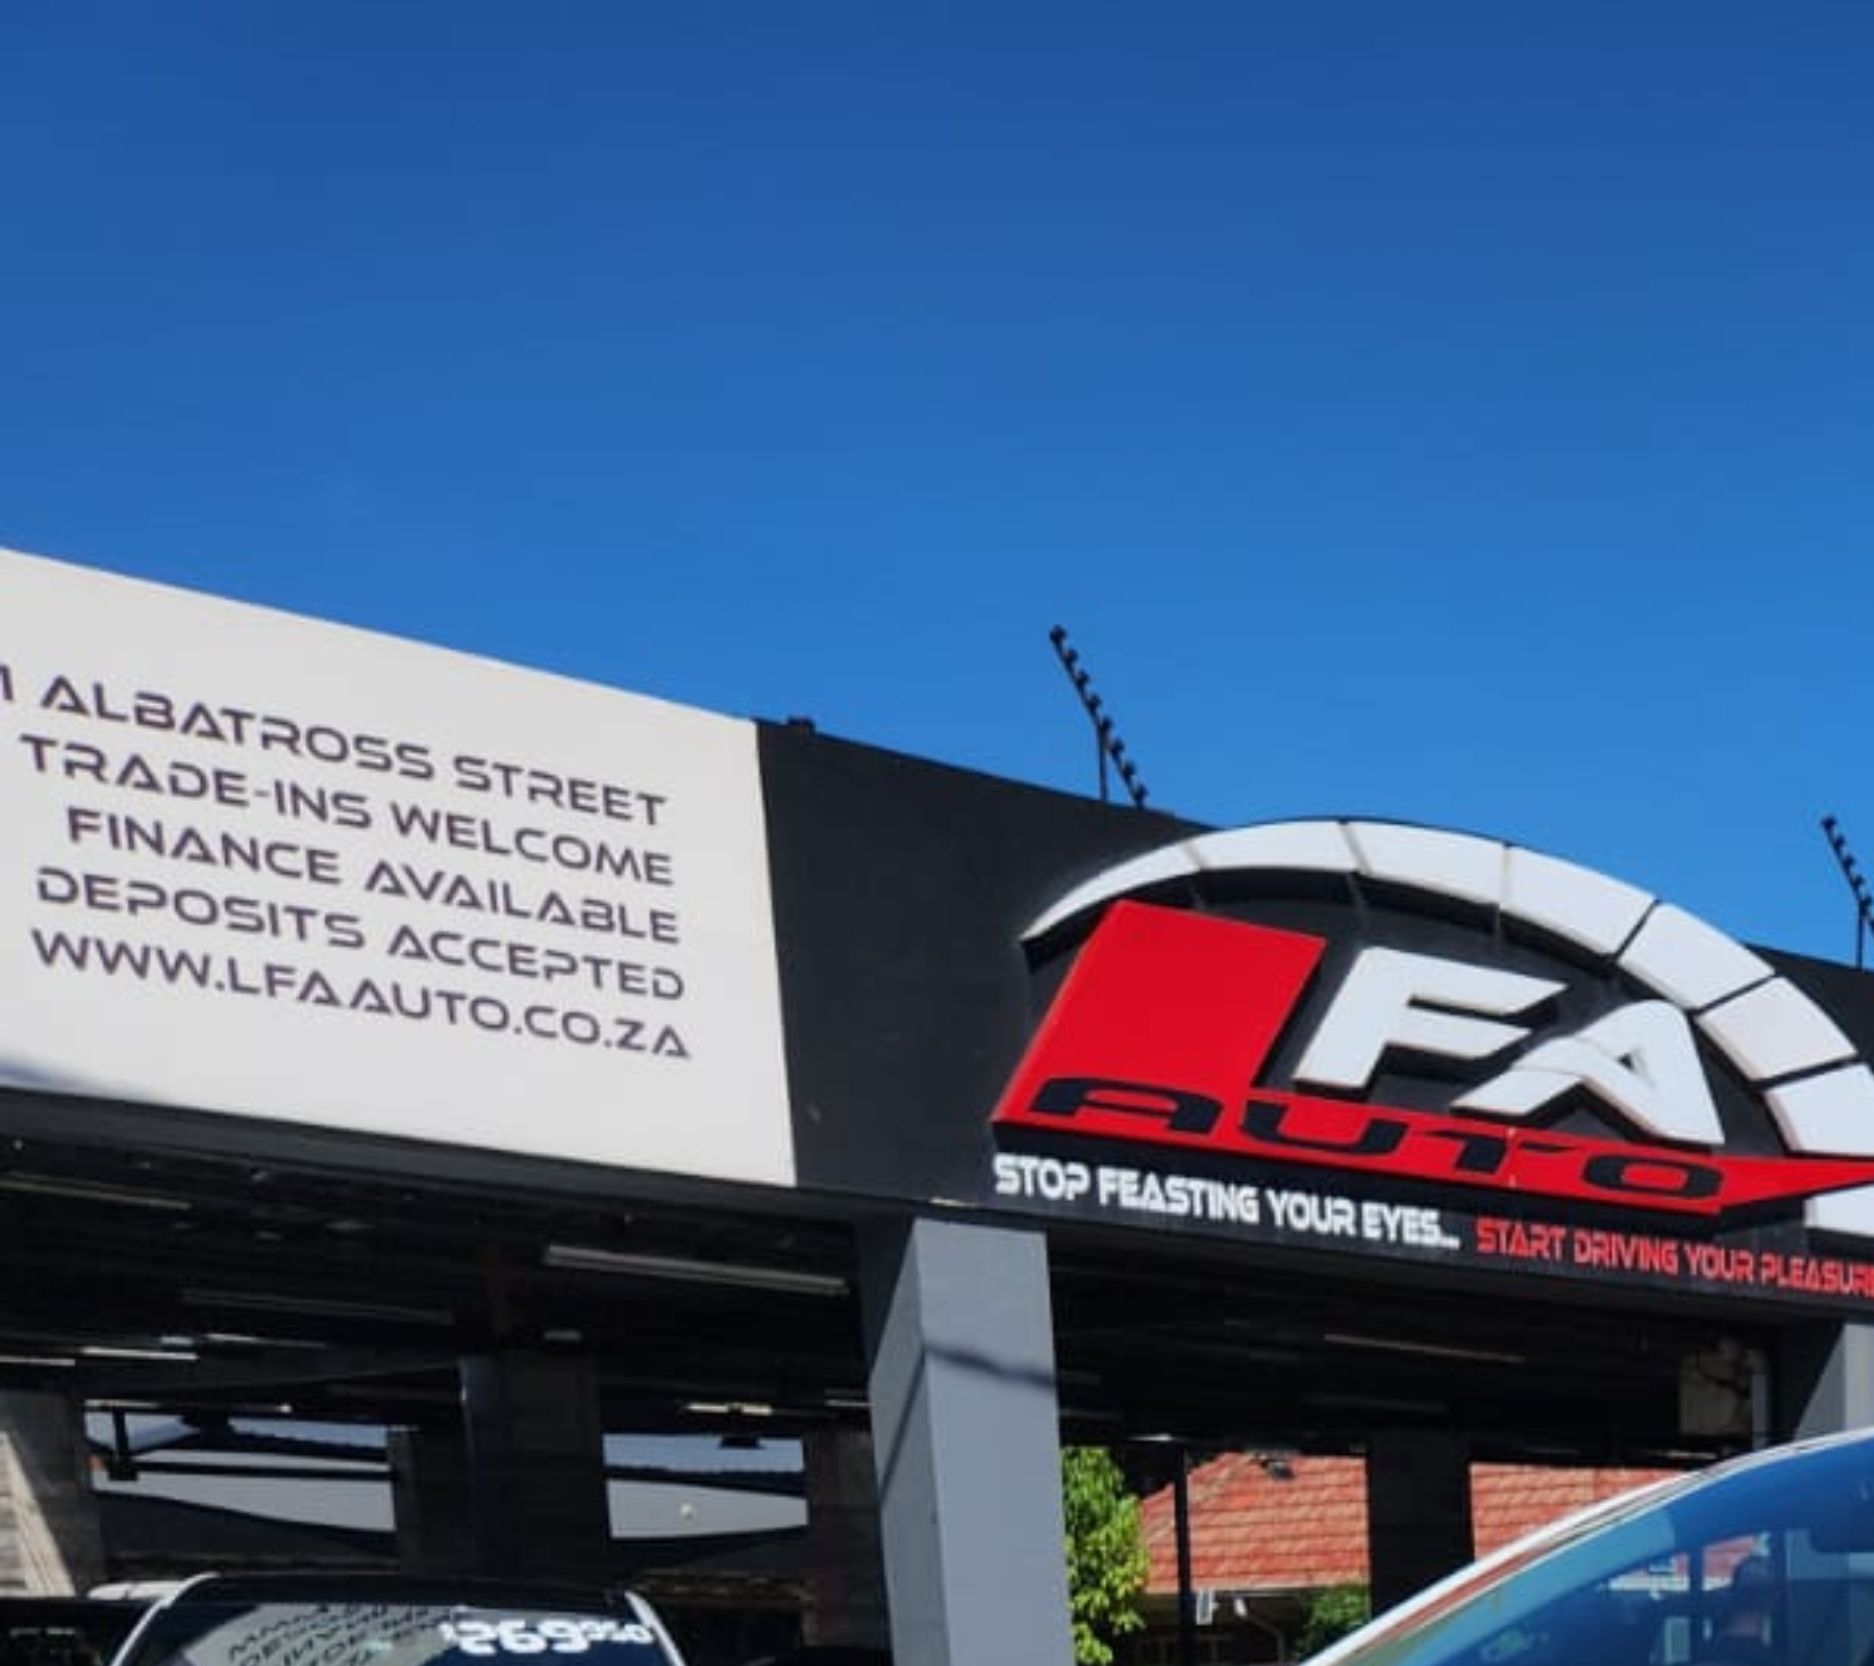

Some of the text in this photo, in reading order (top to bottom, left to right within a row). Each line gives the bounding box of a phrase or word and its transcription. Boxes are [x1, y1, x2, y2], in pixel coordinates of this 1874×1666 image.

[19, 733, 674, 886] TRADE-INS WELCOME
[40, 674, 434, 779] ALBATROSS
[453, 755, 668, 826] STREET
[37, 866, 685, 1001] DEPOSITS ACCEPTED
[66, 805, 680, 945] FINANCE AVAILABLE
[30, 928, 692, 1059] WWW.LFAAUTO.CO.ZA
[1029, 1076, 1724, 1201] AUTO
[993, 1152, 1091, 1200] STOP
[1098, 1165, 1260, 1224] FEASTING
[1268, 1189, 1357, 1237] YOUR
[1476, 1216, 1565, 1261] START
[1573, 1227, 1680, 1276] DRIVING
[1685, 1243, 1754, 1282] YOUR
